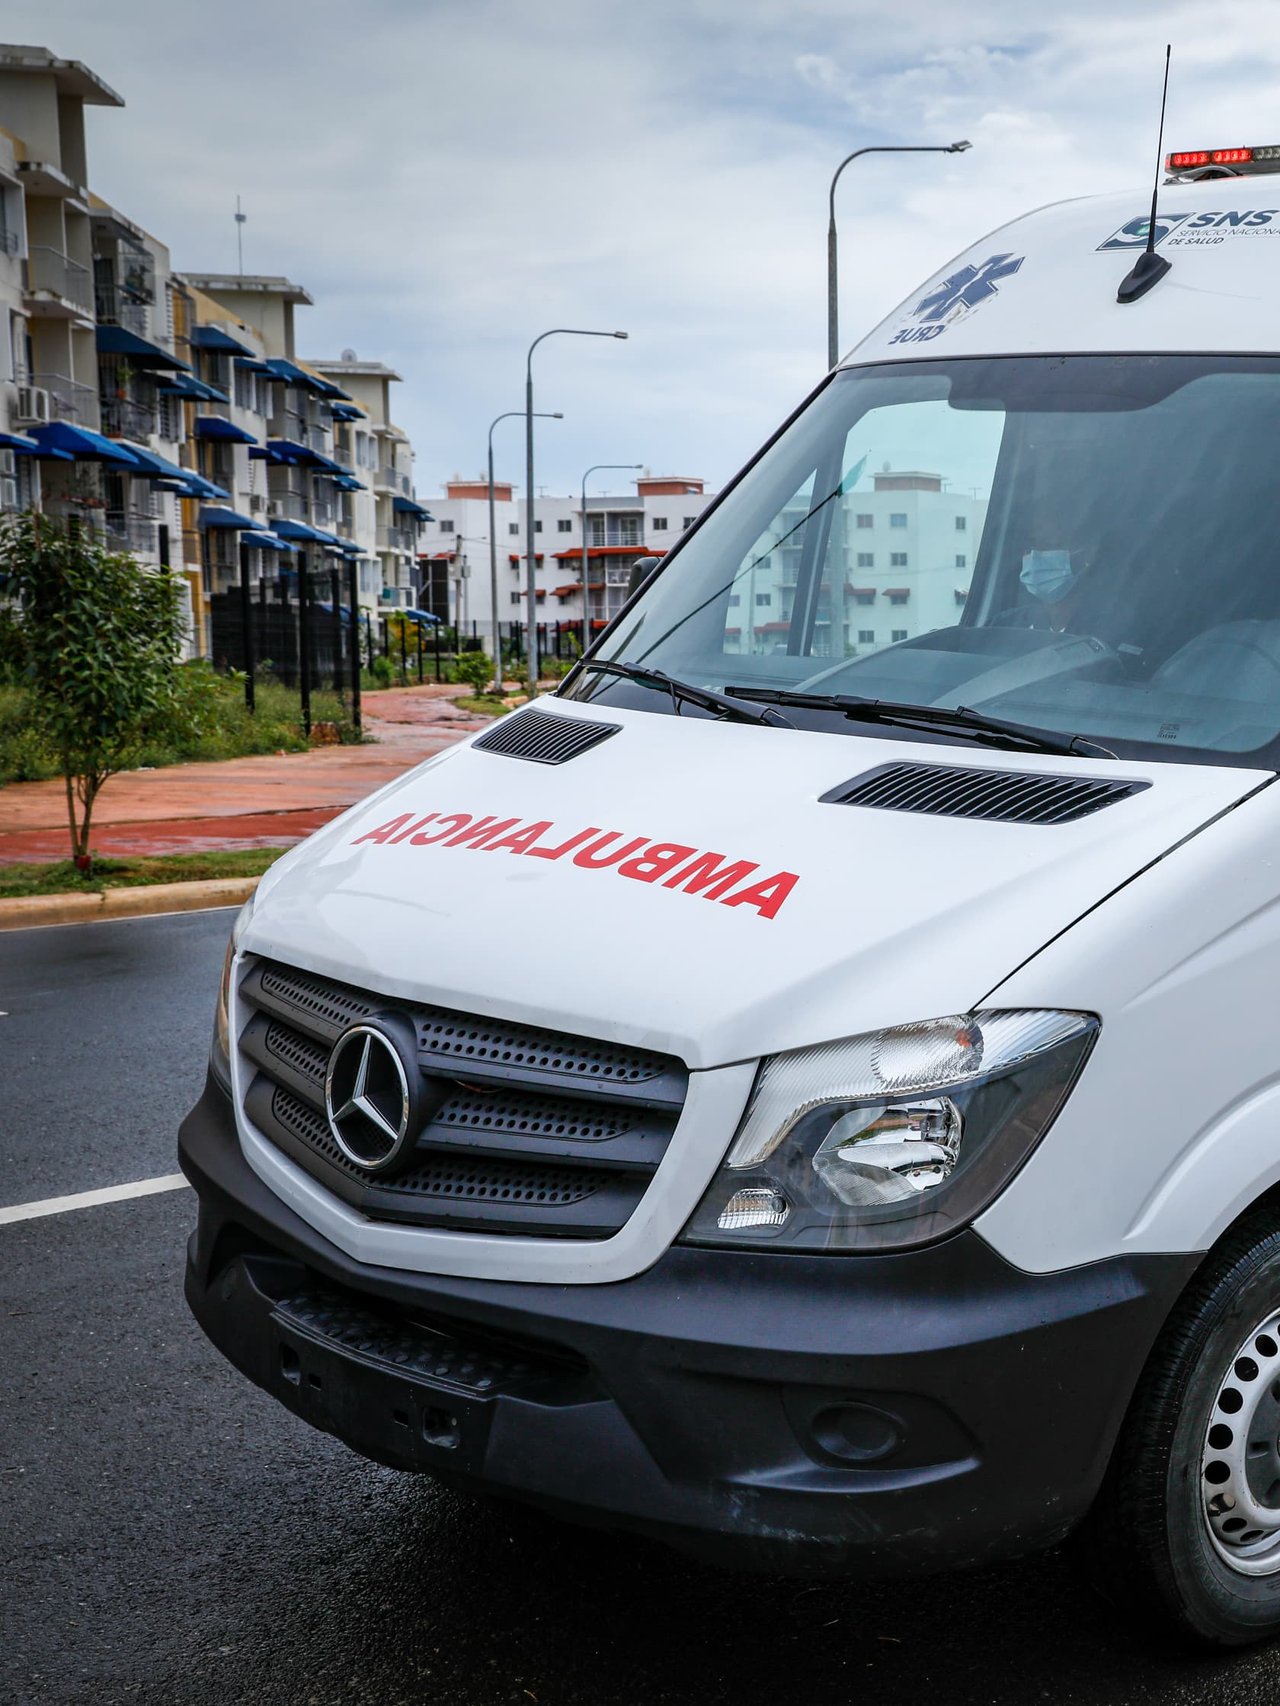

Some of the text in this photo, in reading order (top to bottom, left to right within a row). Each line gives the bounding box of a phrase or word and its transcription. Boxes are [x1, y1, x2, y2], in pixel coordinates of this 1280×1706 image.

[1187, 209, 1280, 228] SNS
[1177, 229, 1228, 237] SERVICIO
[1184, 237, 1224, 245] SALUD
